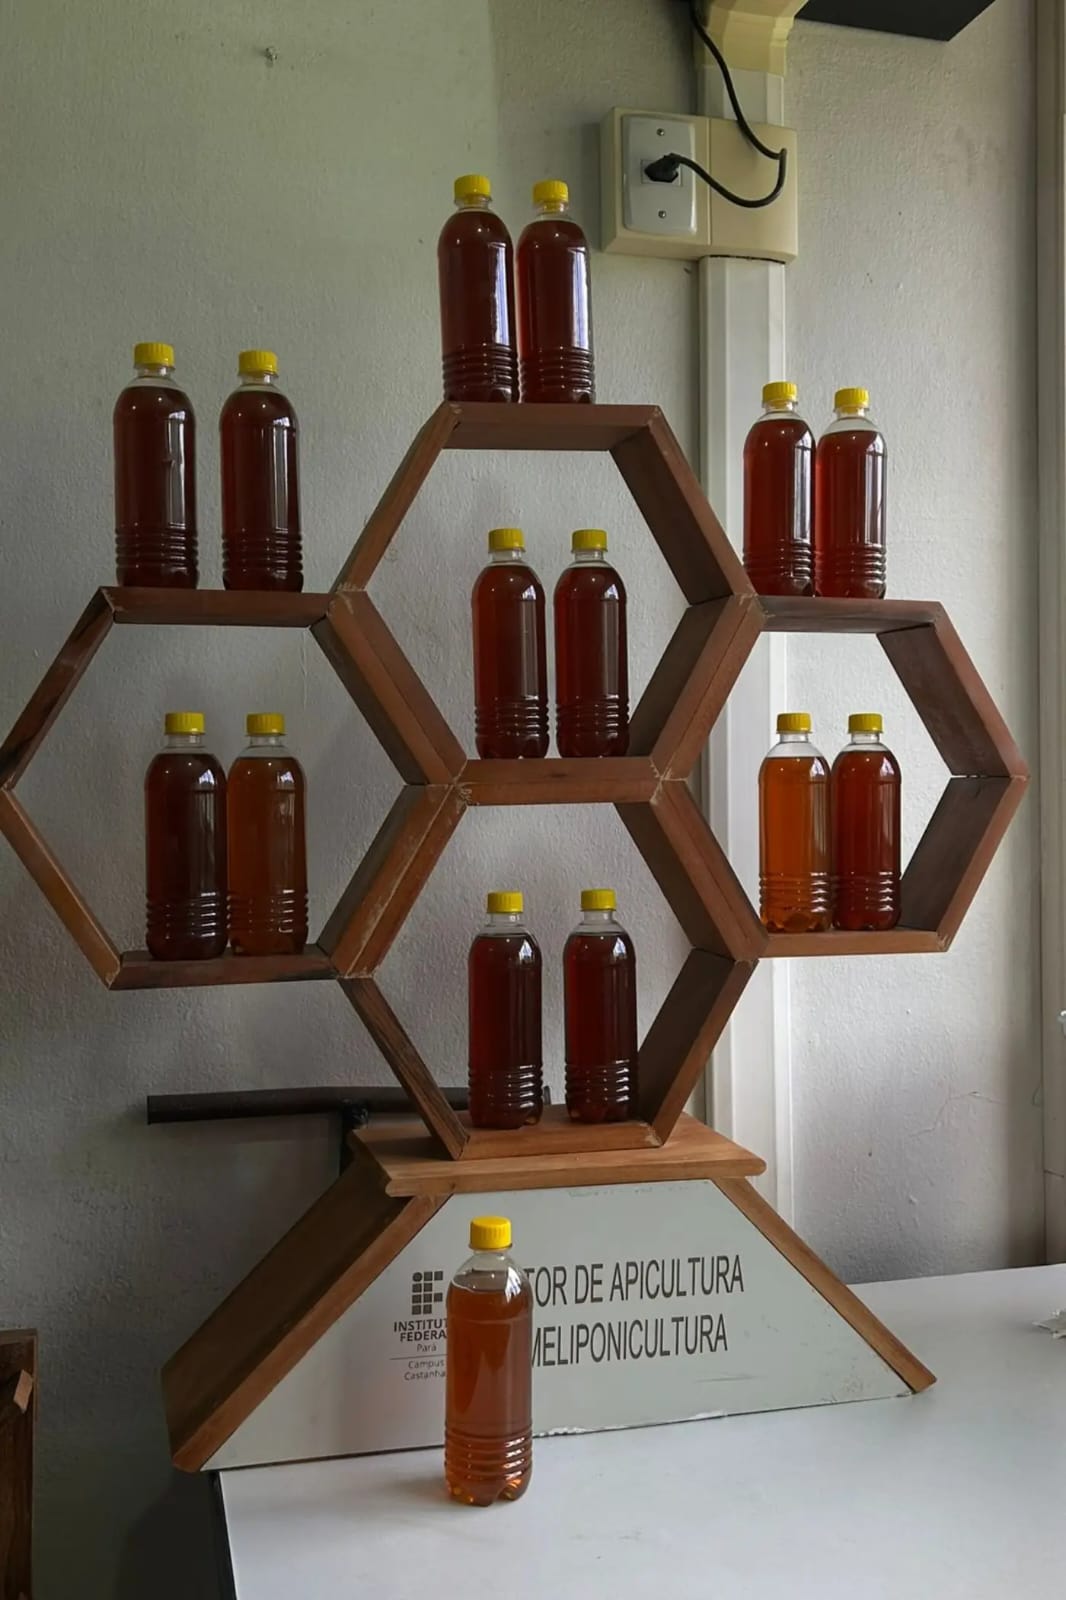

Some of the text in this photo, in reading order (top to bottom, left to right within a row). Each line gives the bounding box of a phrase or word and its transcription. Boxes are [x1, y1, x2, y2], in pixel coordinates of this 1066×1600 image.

[574, 1263, 603, 1304] DE
[609, 1254, 744, 1301] APICULTURA
[416, 1342, 437, 1352] Pará
[408, 1359, 444, 1370] Campus
